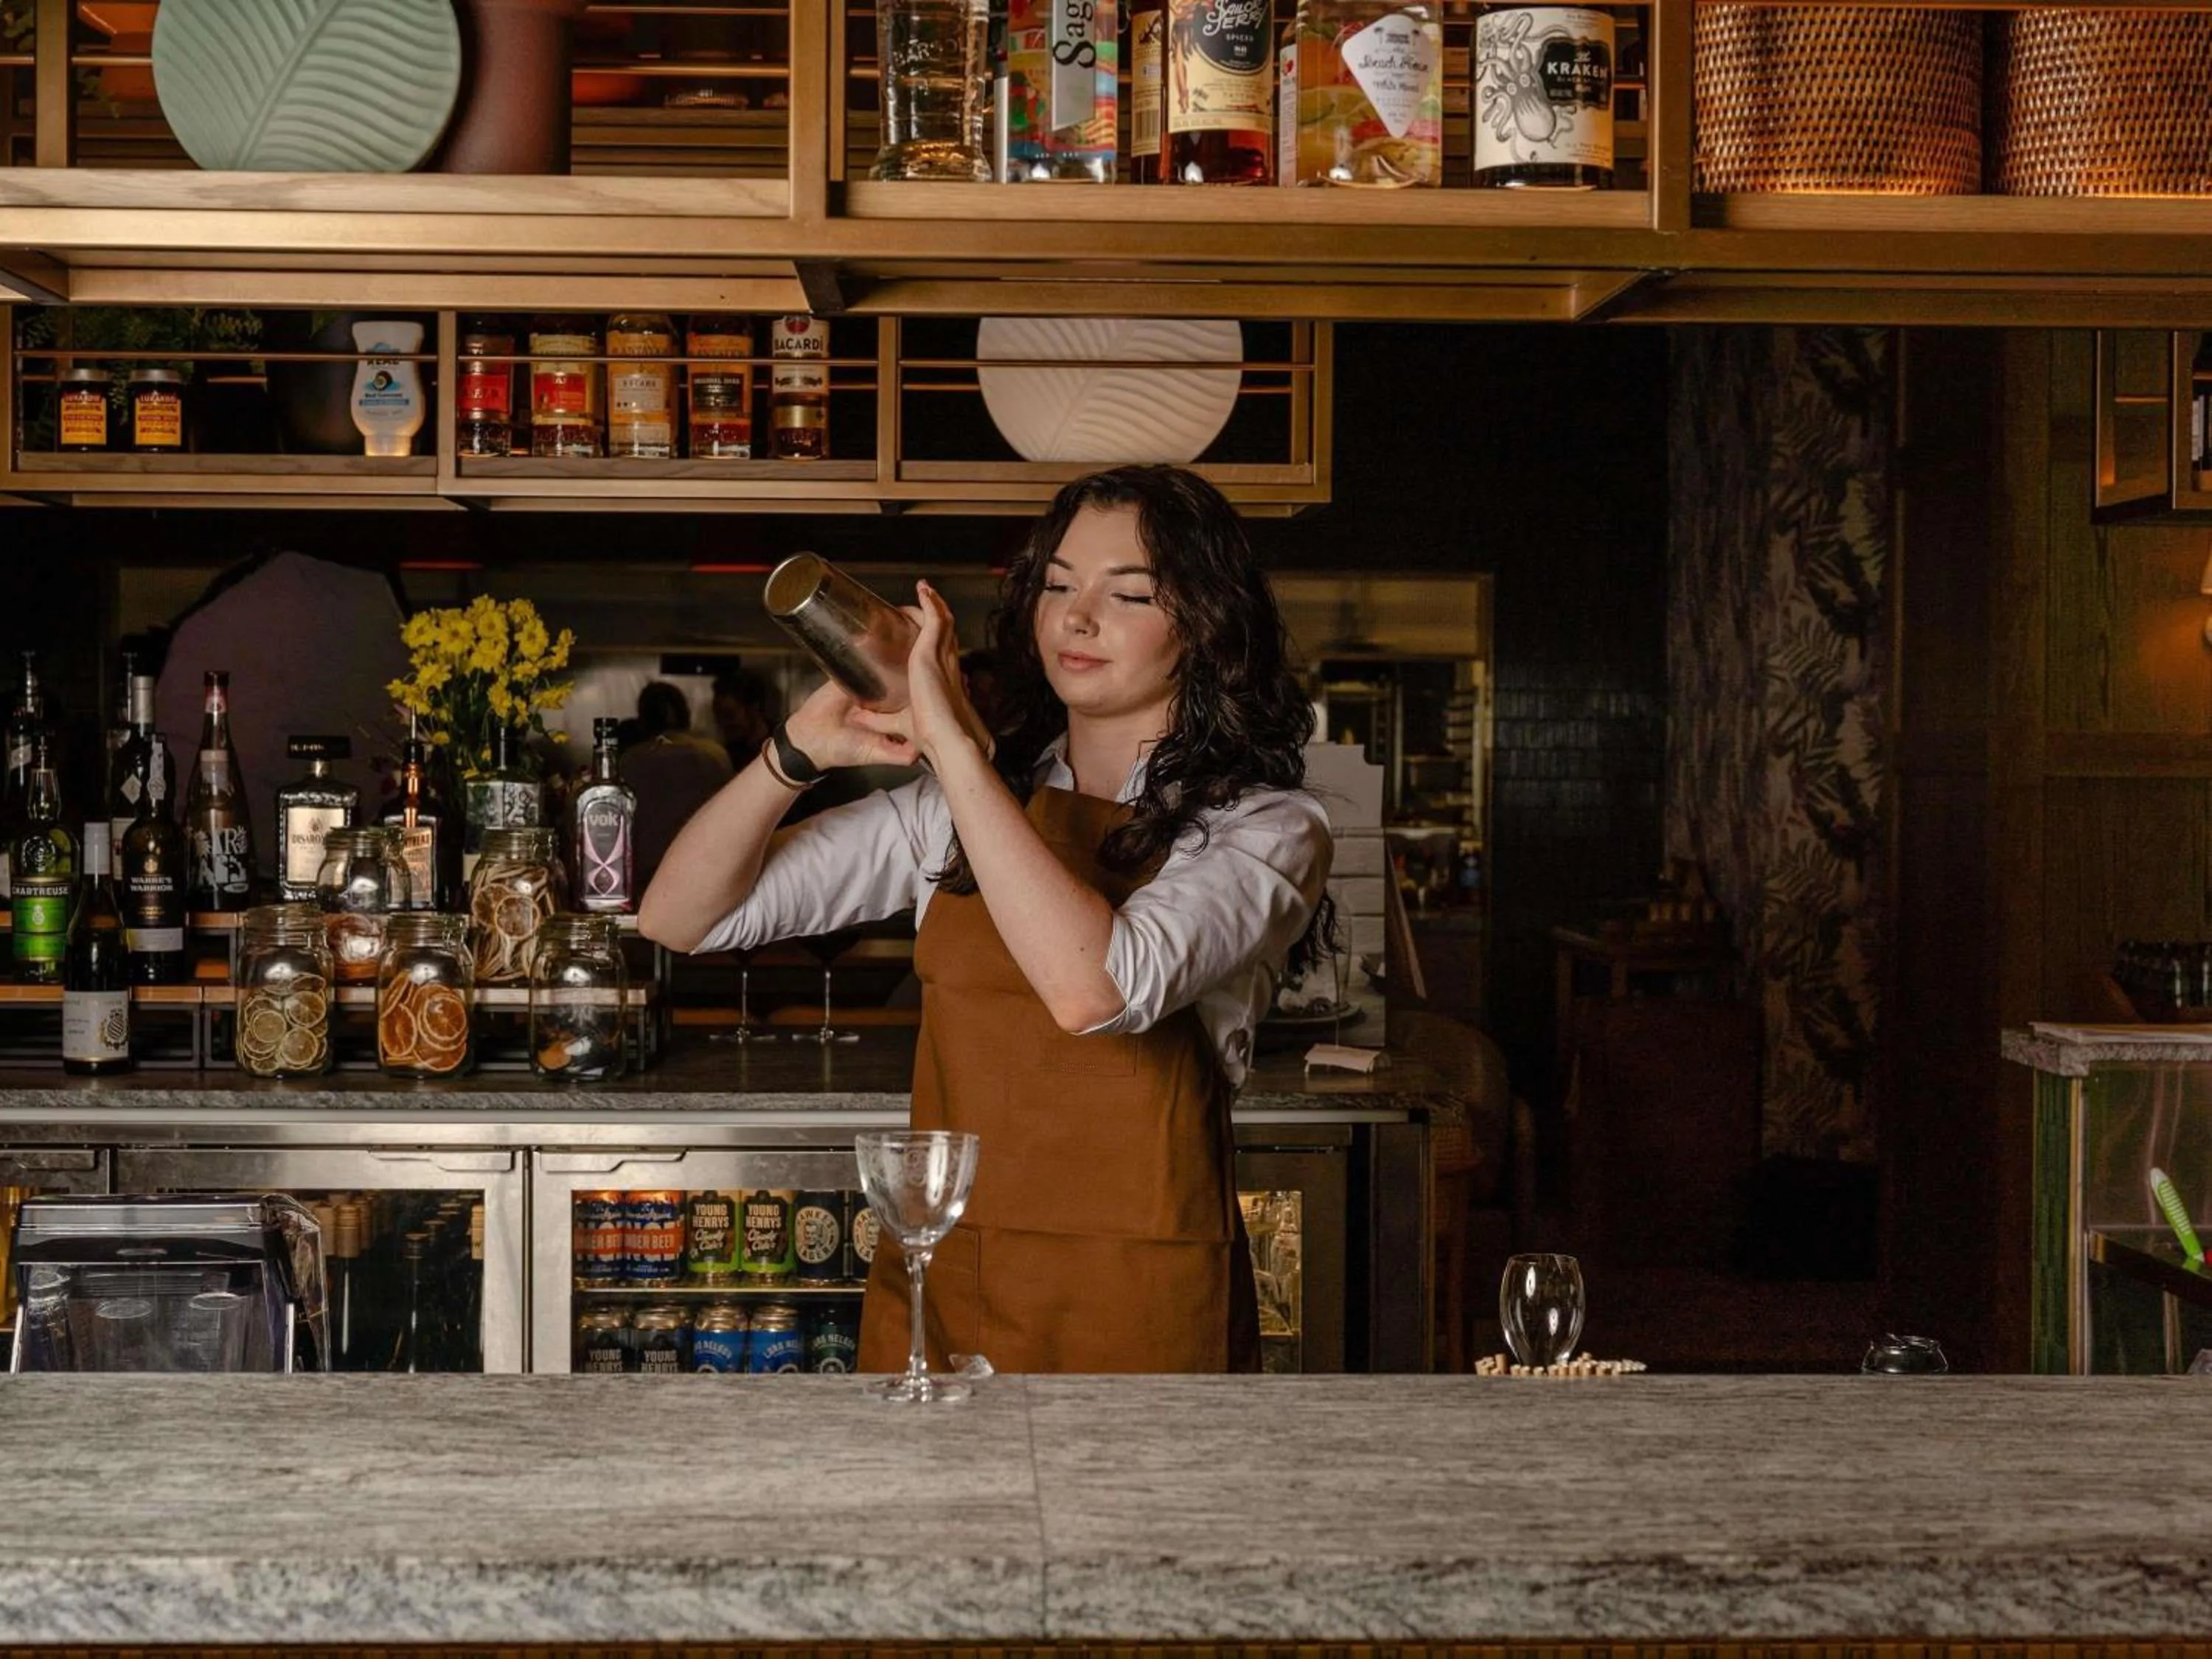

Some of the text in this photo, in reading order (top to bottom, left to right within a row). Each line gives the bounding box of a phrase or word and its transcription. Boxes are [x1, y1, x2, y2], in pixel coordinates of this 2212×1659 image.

[1548, 61, 1608, 78] KRAKEN
[589, 812, 619, 827] vok
[695, 1204, 728, 1216] YOUNG
[748, 1204, 779, 1216] YOUNG
[692, 1216, 729, 1228] HENRYS
[745, 1217, 782, 1228] HENRYS
[589, 1349, 622, 1361] YOUNG
[644, 1349, 677, 1363] YOUNG
